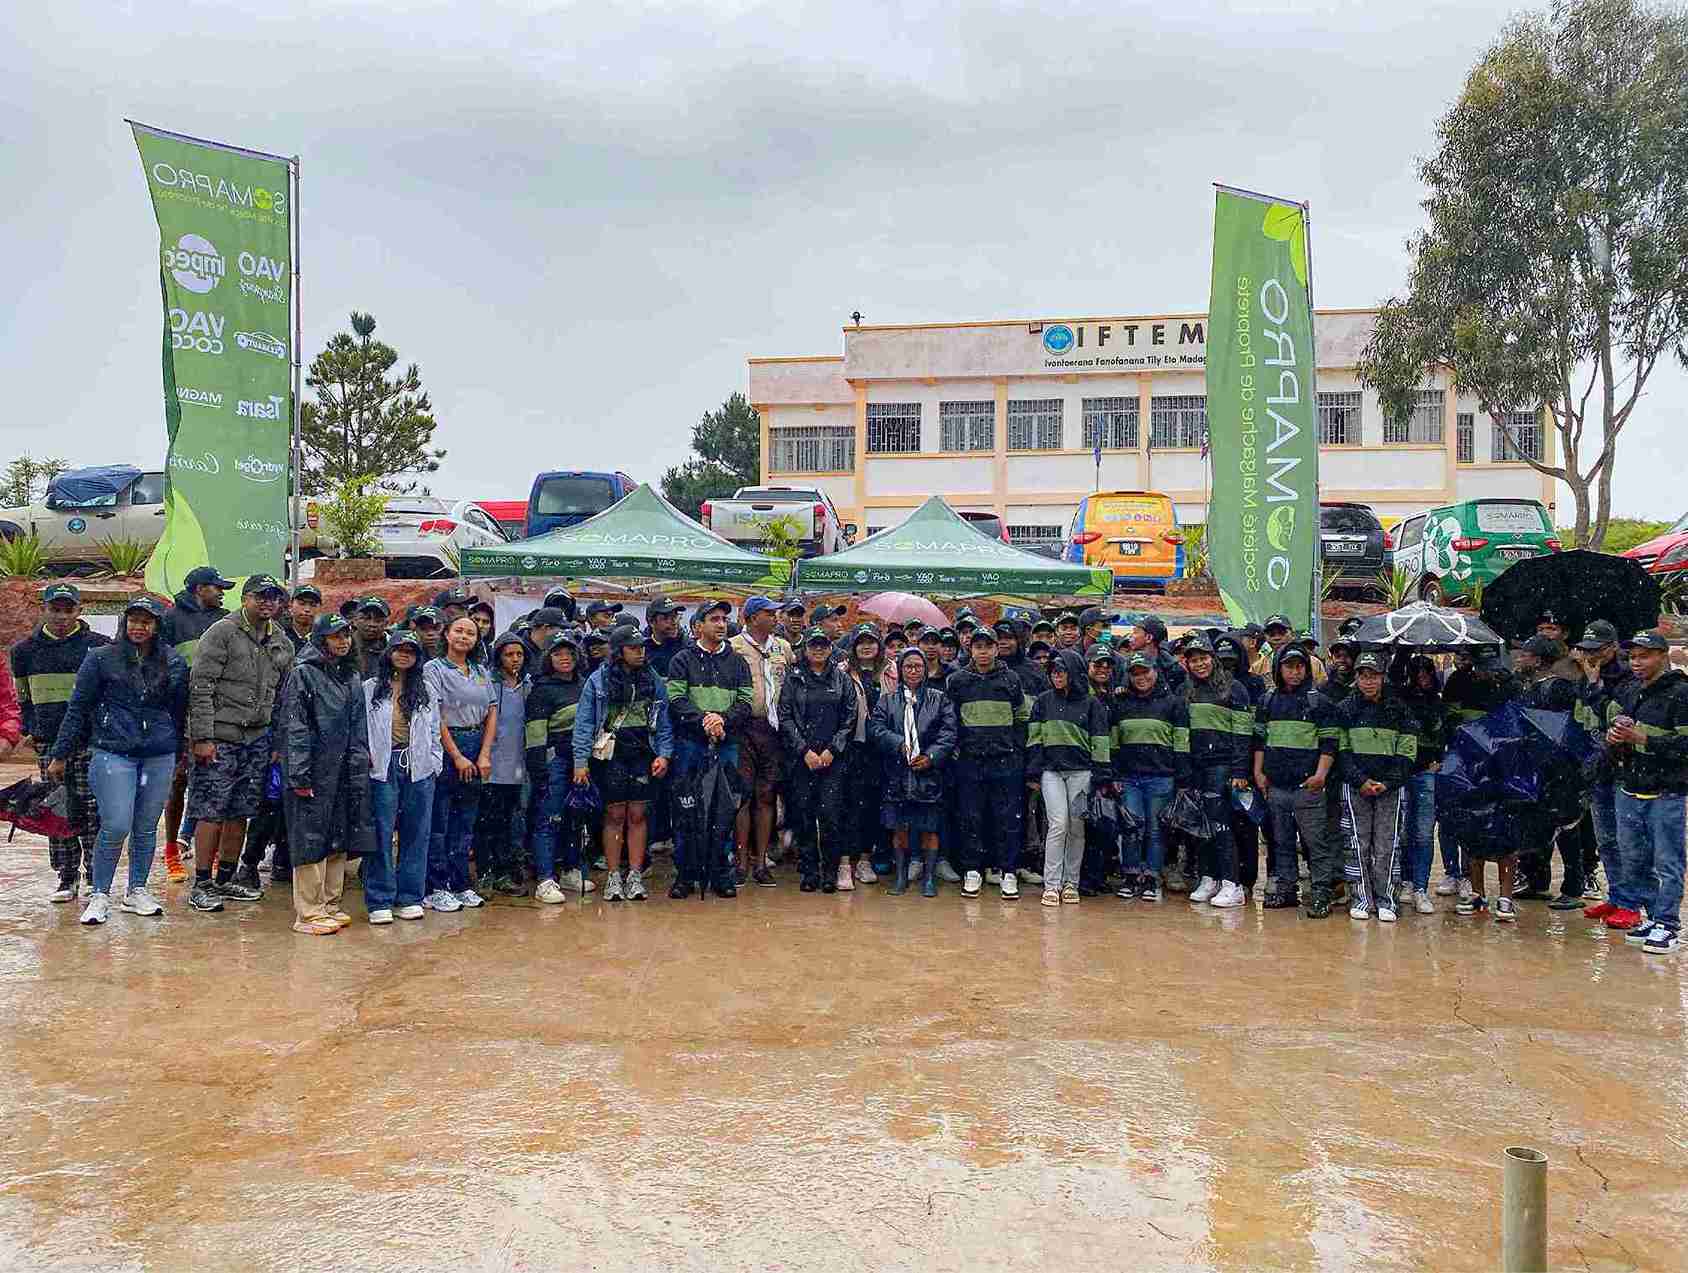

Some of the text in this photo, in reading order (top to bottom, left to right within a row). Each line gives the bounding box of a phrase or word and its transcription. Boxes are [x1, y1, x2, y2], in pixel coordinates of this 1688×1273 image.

[1096, 356, 1145, 366] Fanofanana
[1147, 355, 1162, 366] Tily
[559, 533, 714, 548] SOMAPRO
[657, 558, 676, 567] VAO
